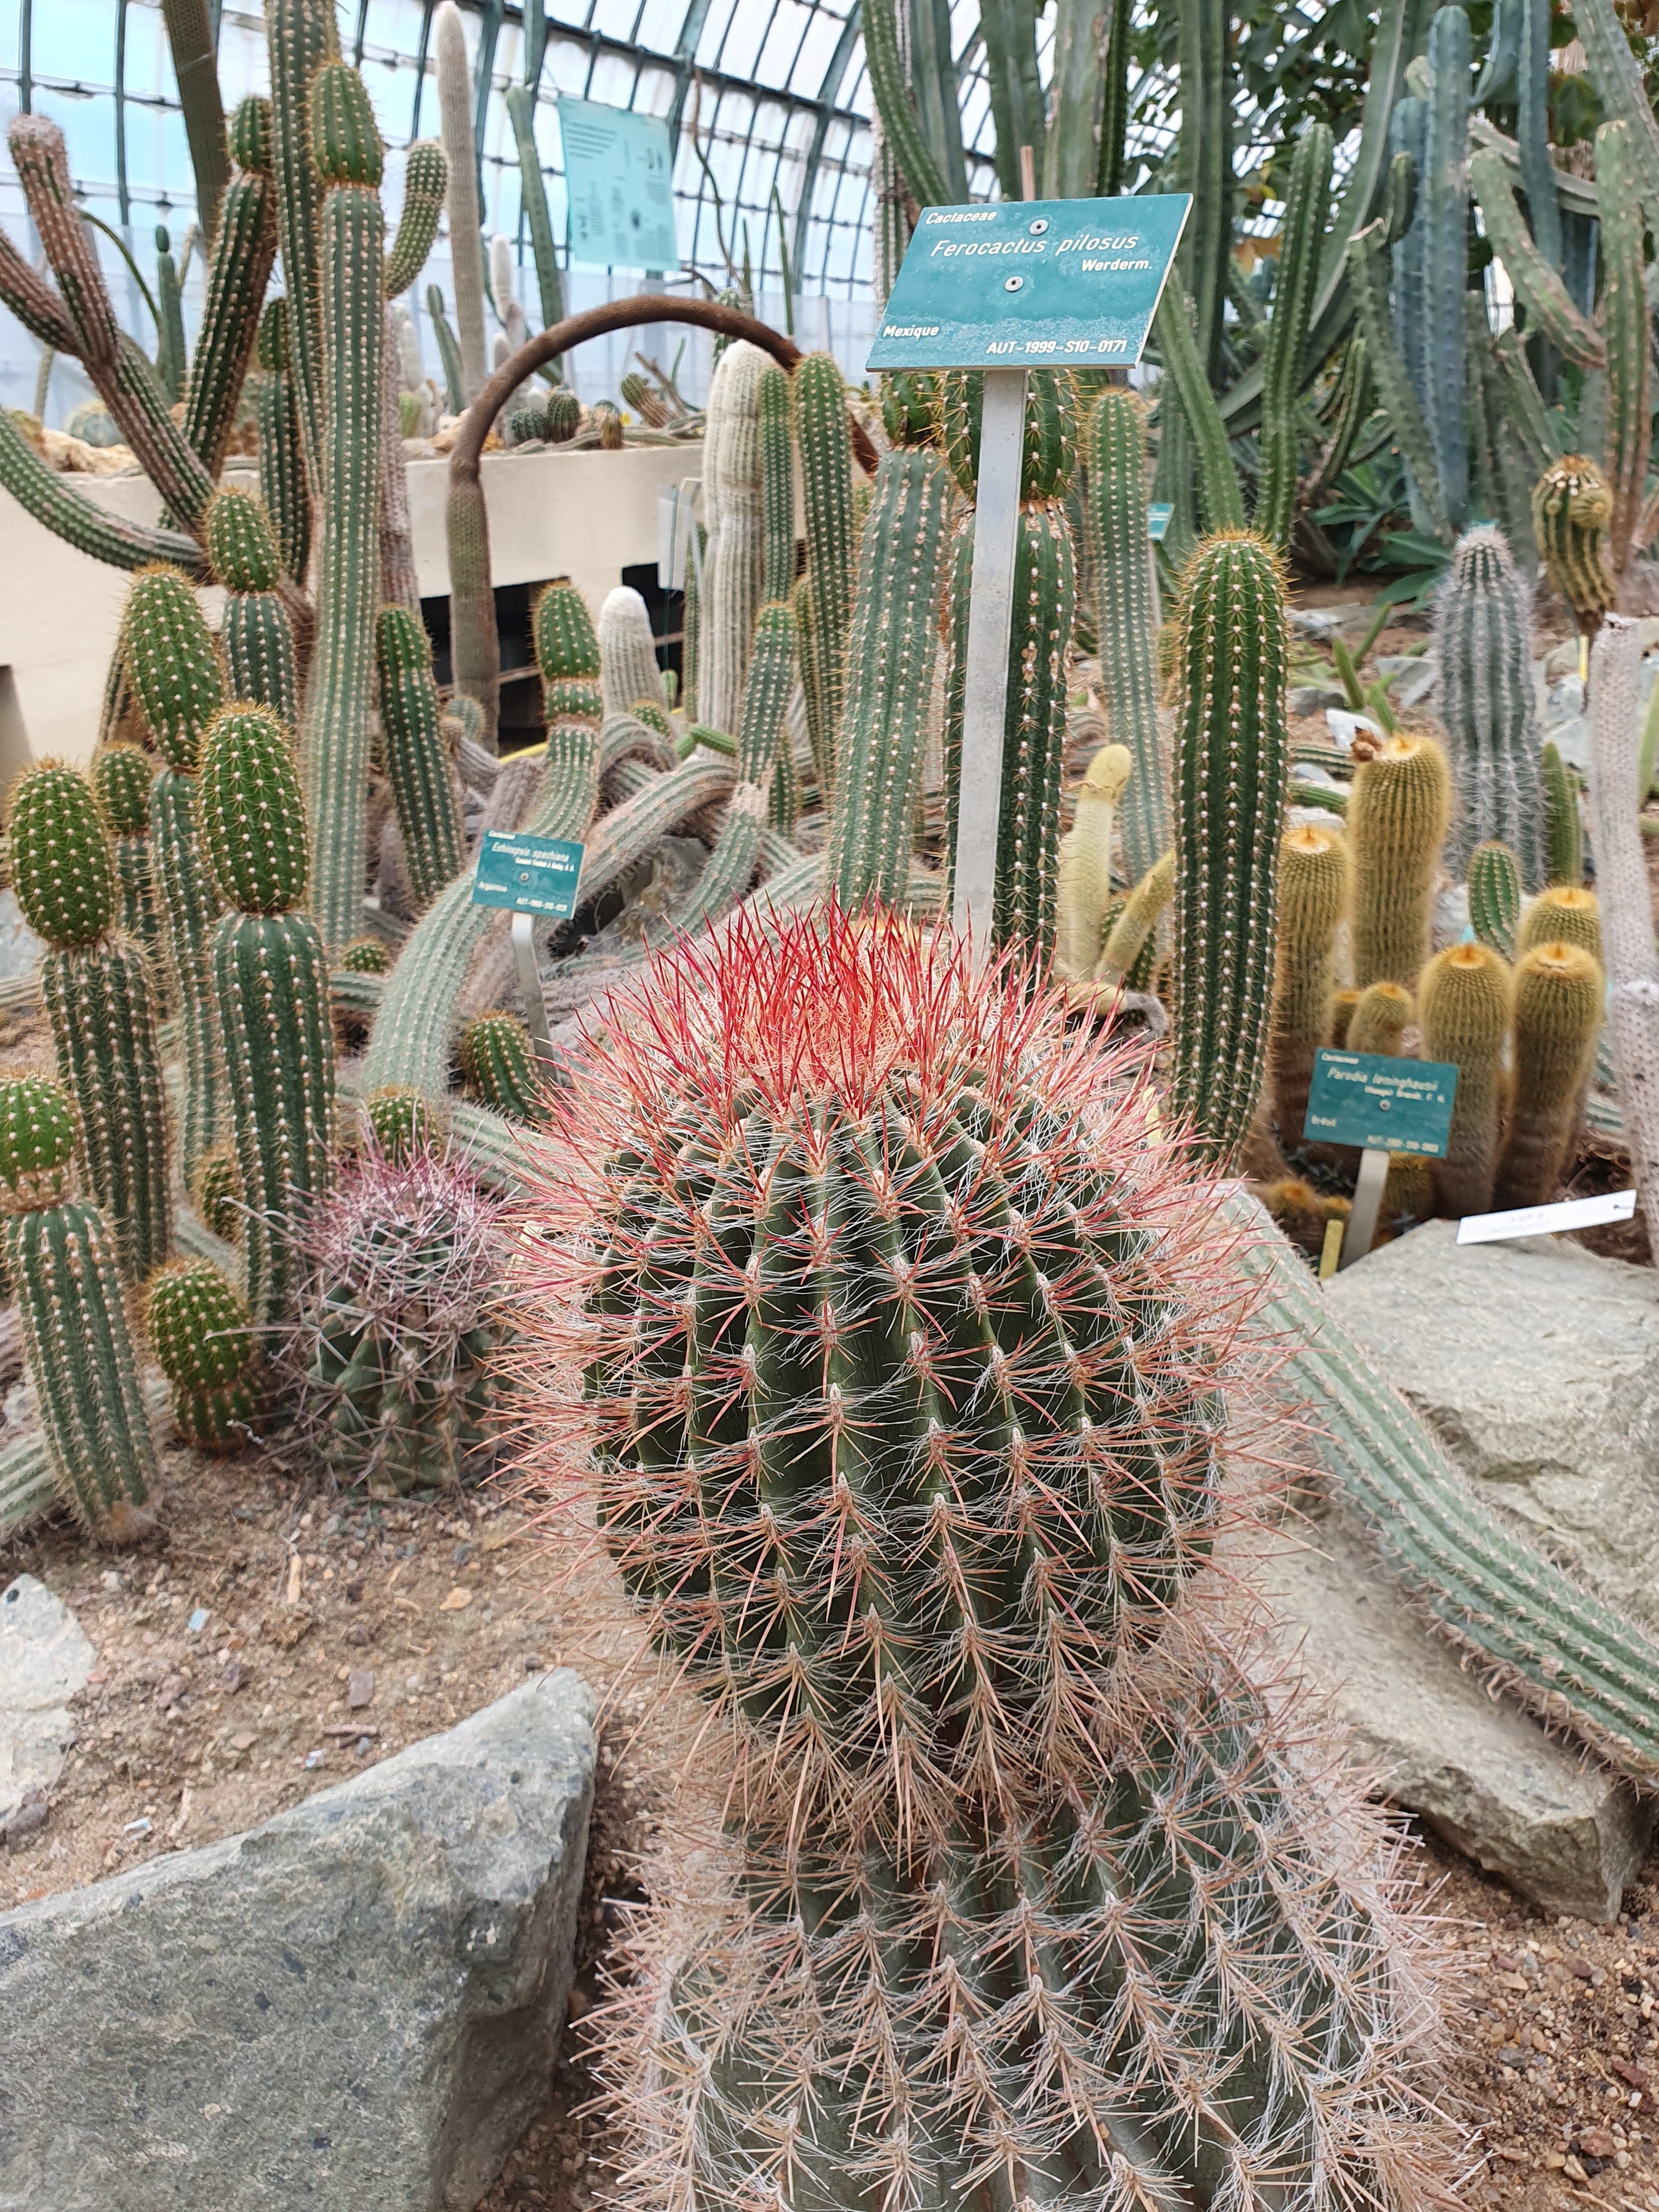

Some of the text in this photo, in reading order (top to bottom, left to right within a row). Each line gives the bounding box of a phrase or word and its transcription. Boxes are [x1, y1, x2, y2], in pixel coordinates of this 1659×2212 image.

[926, 211, 997, 224] Cactaceae
[930, 234, 1139, 257] Ferocactus pilosus
[1081, 258, 1153, 272] Werderm.
[883, 325, 939, 340] Mexique
[986, 340, 1128, 354] AUT-1999-S10-0171
[1327, 1067, 1368, 1084] Parodia
